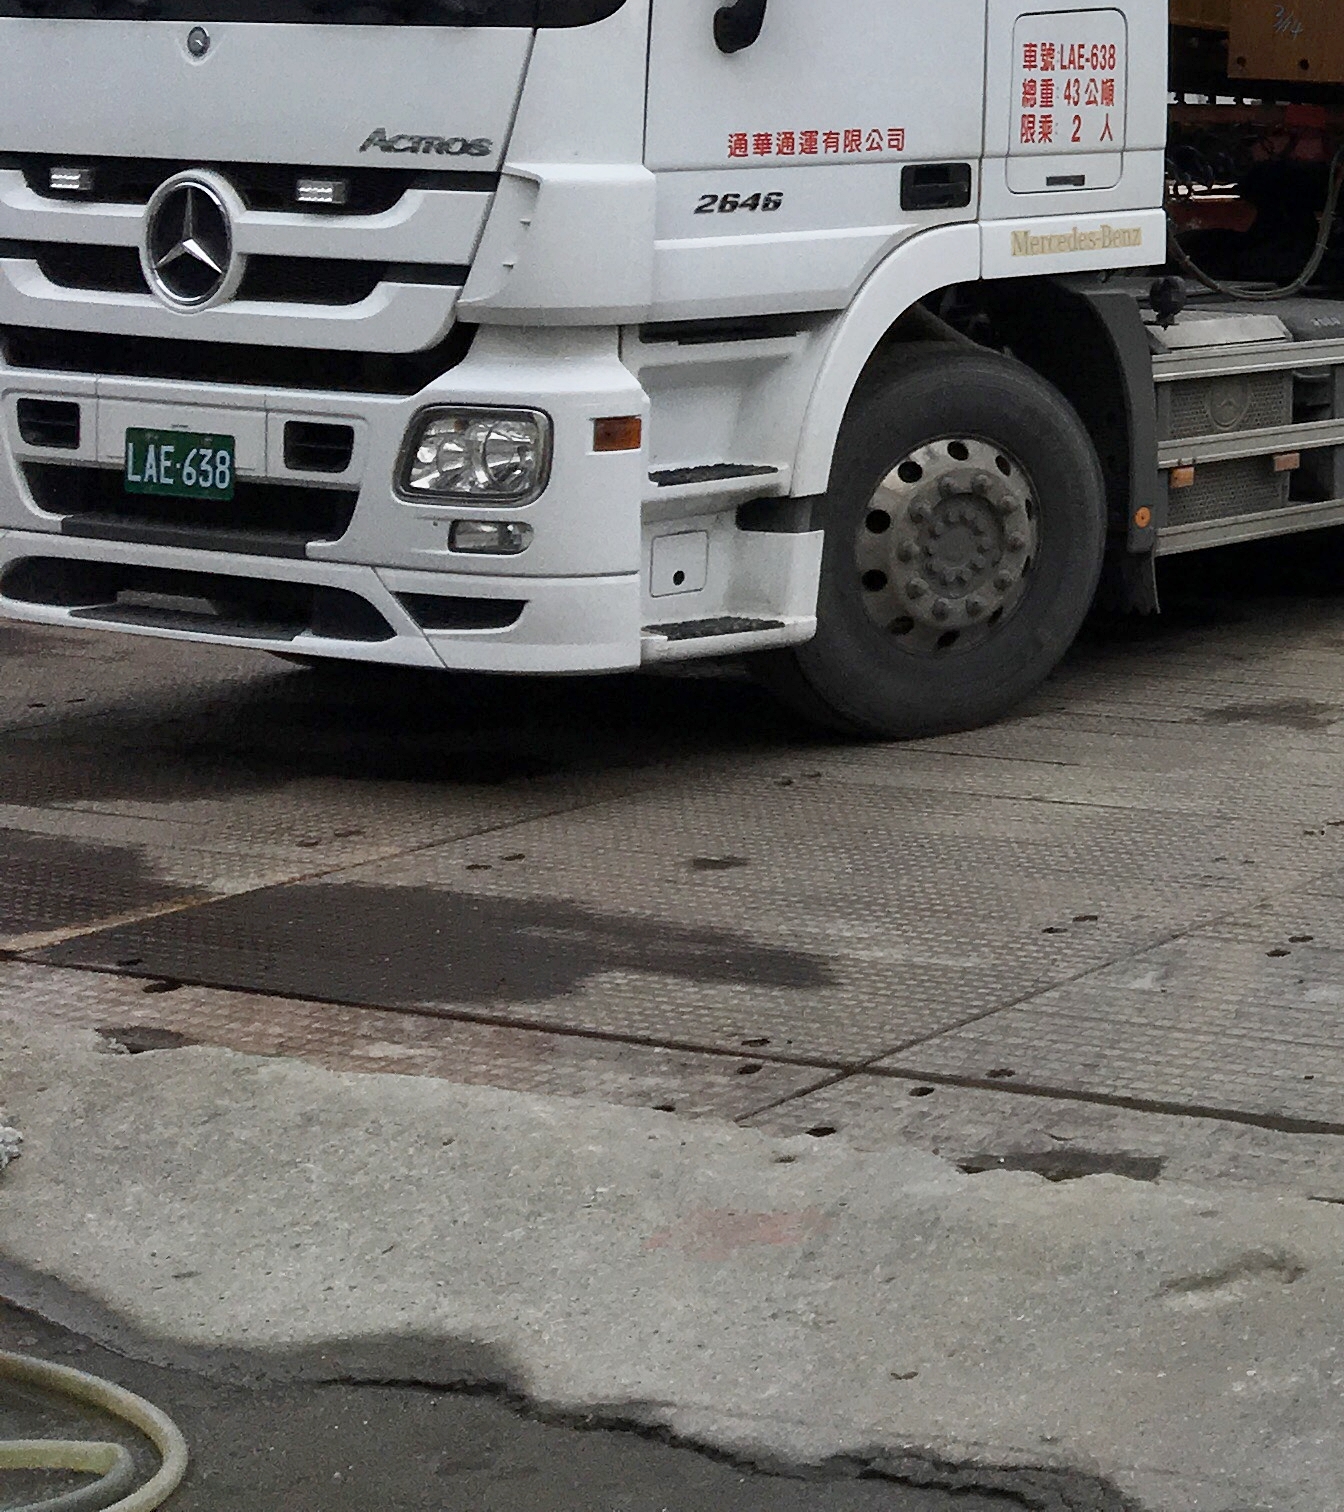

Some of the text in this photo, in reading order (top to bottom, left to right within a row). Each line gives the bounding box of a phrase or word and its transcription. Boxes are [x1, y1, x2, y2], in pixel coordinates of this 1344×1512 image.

[727, 128, 905, 158] 通華通運有限公司
[694, 191, 784, 214] 2646
[1011, 224, 1142, 256] Mercedes-Benz
